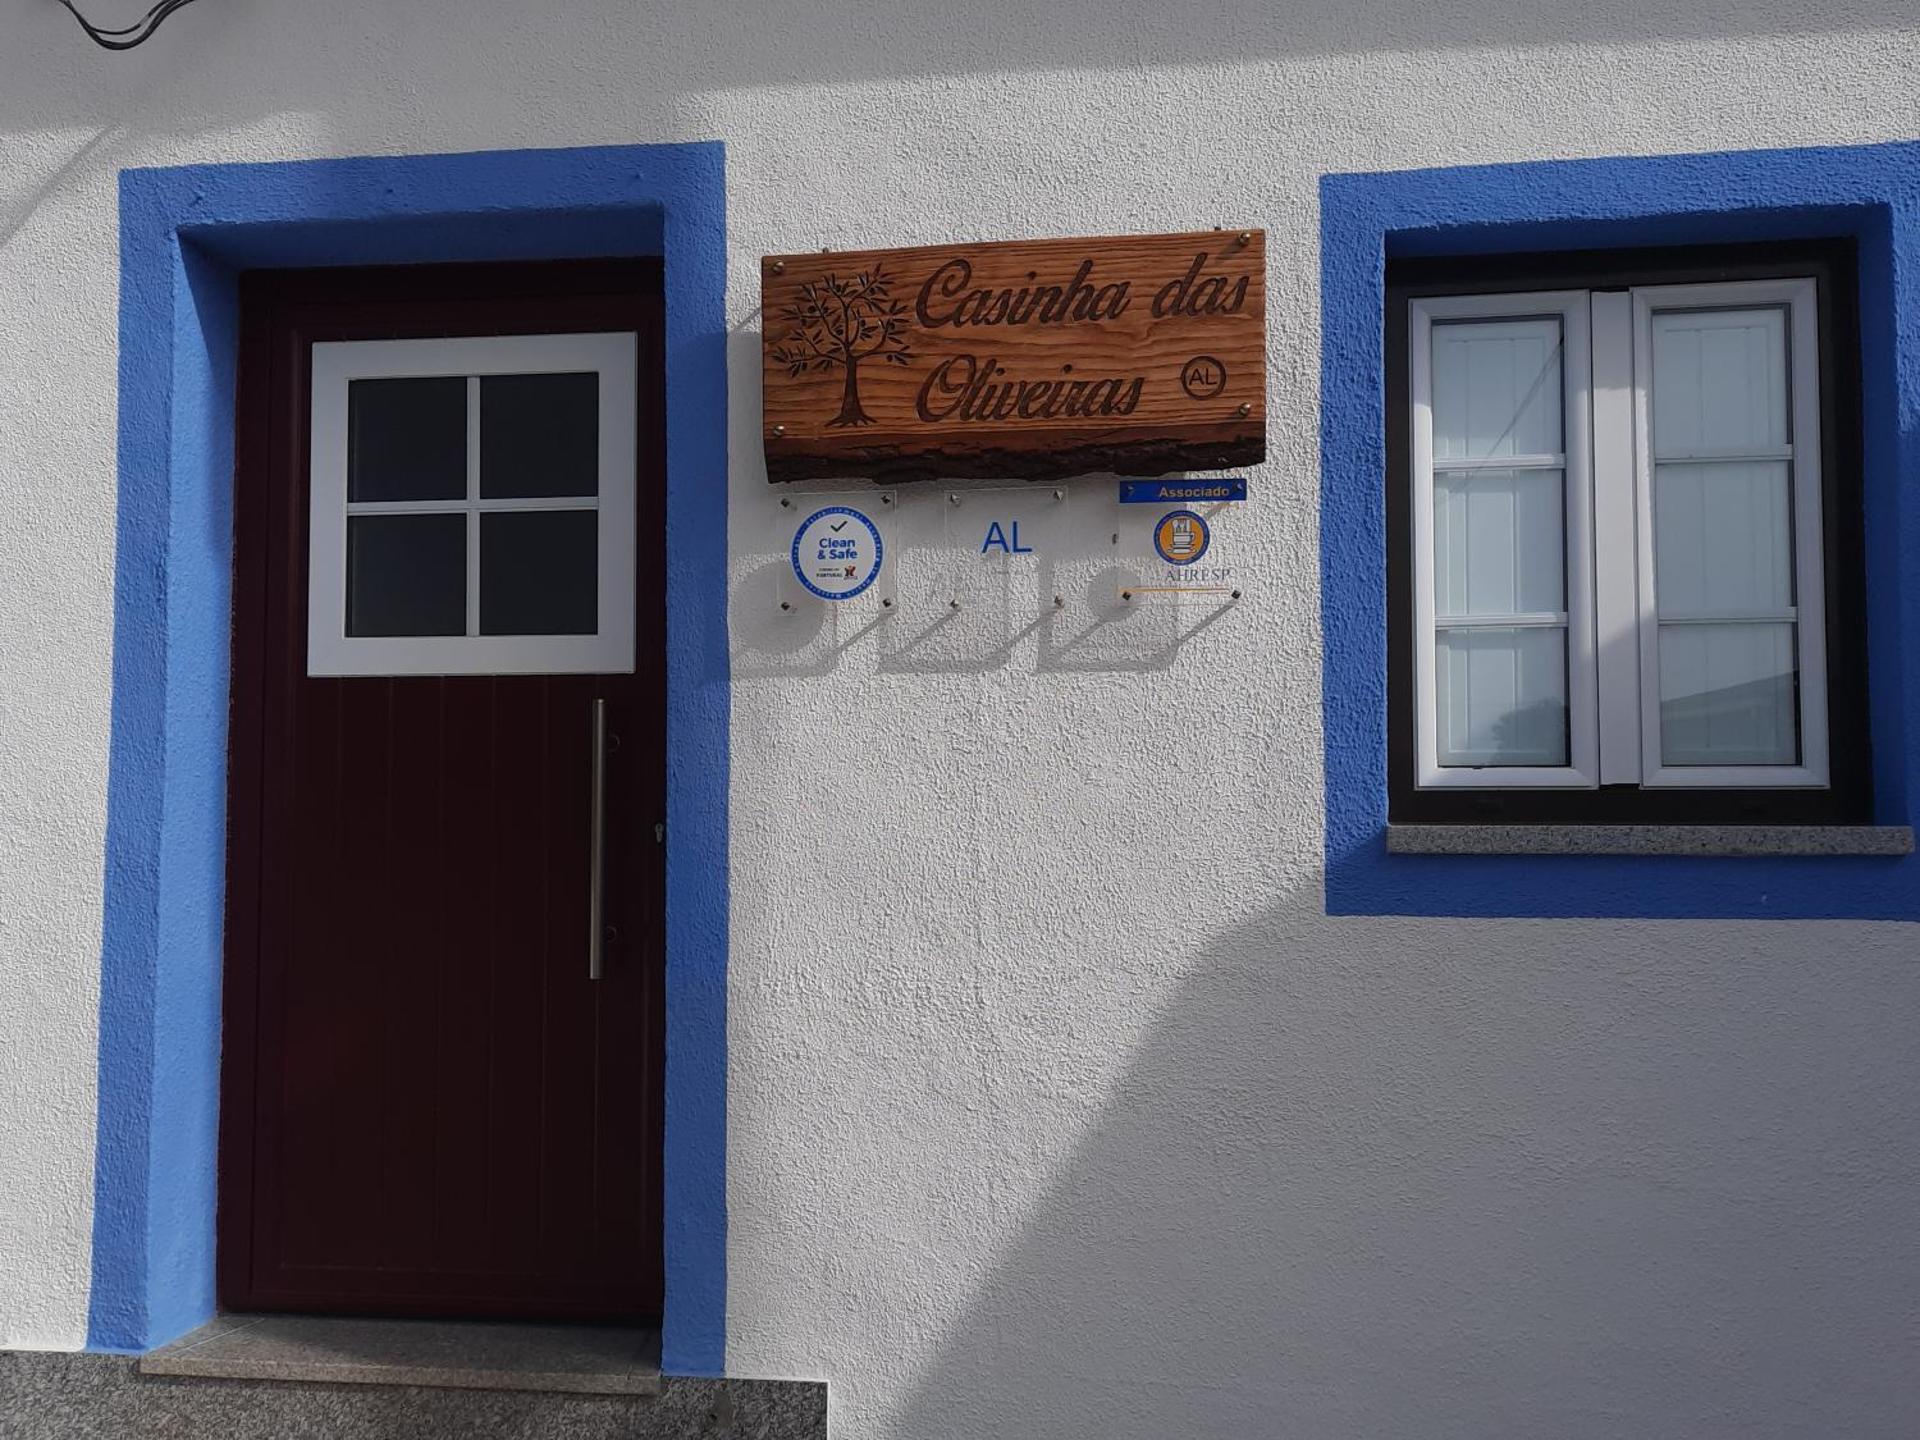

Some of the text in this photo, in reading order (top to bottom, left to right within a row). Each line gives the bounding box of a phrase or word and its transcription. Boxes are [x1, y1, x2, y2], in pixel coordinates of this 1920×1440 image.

[915, 252, 1250, 329] Casinha das
[1189, 368, 1218, 386] AL
[914, 353, 1145, 423] Oliveiras
[1159, 486, 1230, 498] Associado
[819, 538, 856, 549] Clean
[981, 520, 1033, 553] AL
[817, 549, 858, 560] & Safe
[1165, 568, 1231, 581] AHRESP
